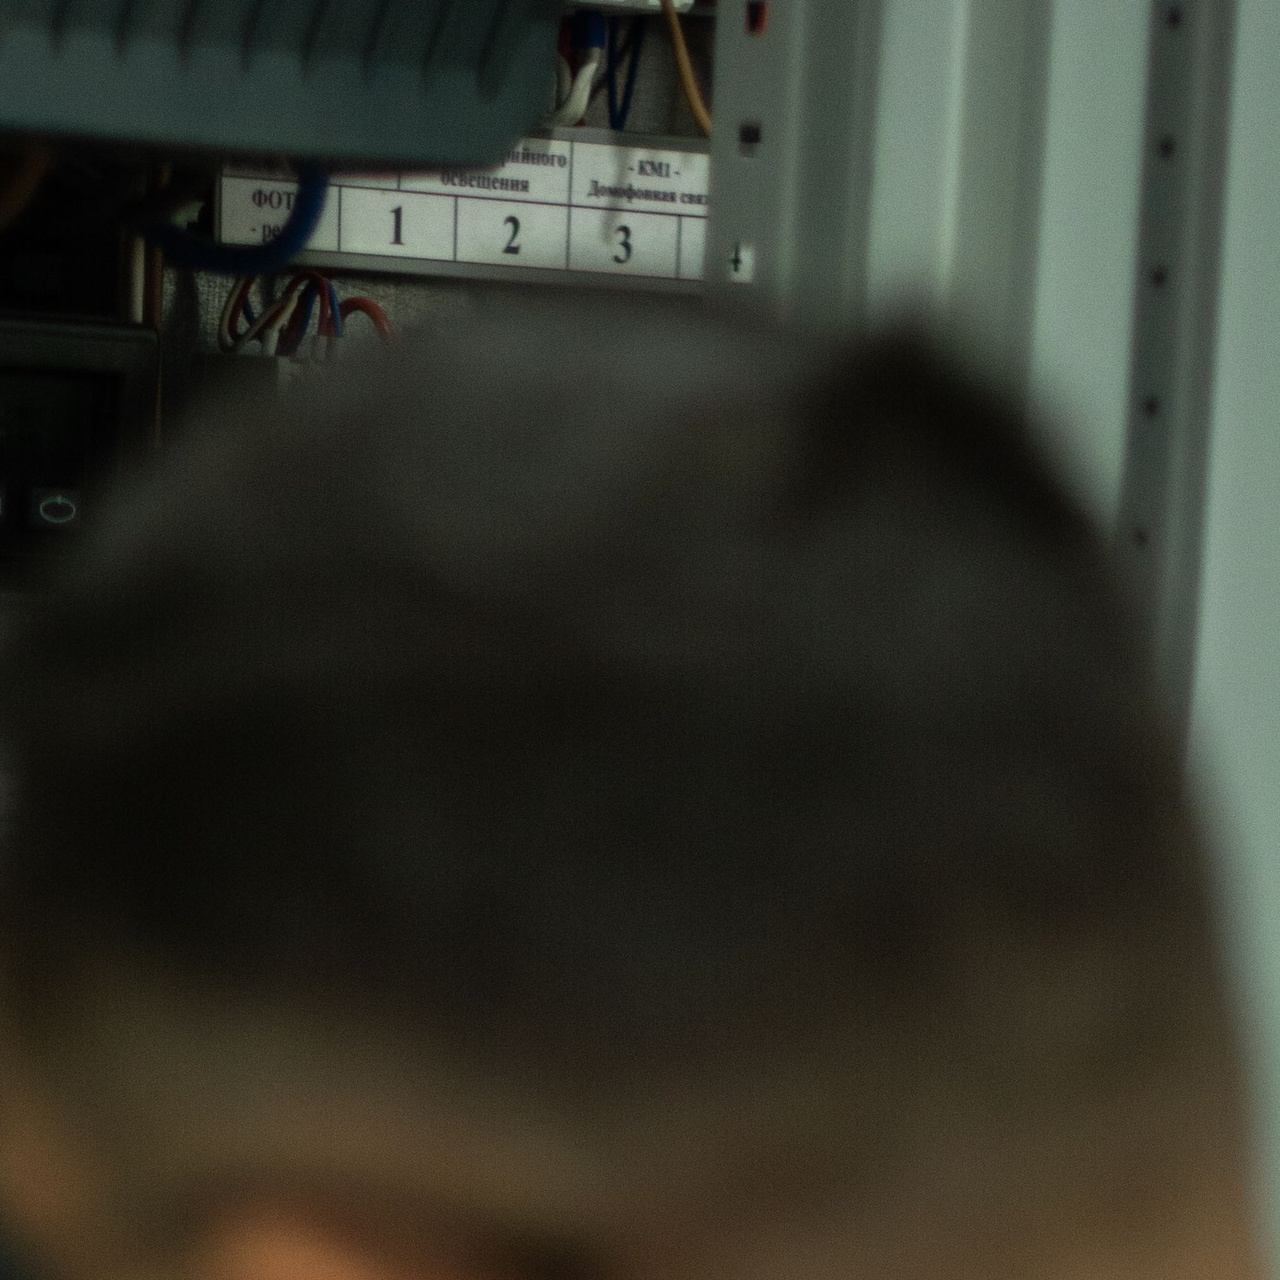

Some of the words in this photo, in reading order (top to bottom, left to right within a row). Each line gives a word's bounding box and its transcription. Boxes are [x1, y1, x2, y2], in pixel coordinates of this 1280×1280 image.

[390, 206, 404, 245] 1
[502, 216, 522, 255] 2
[612, 225, 633, 264] 3
